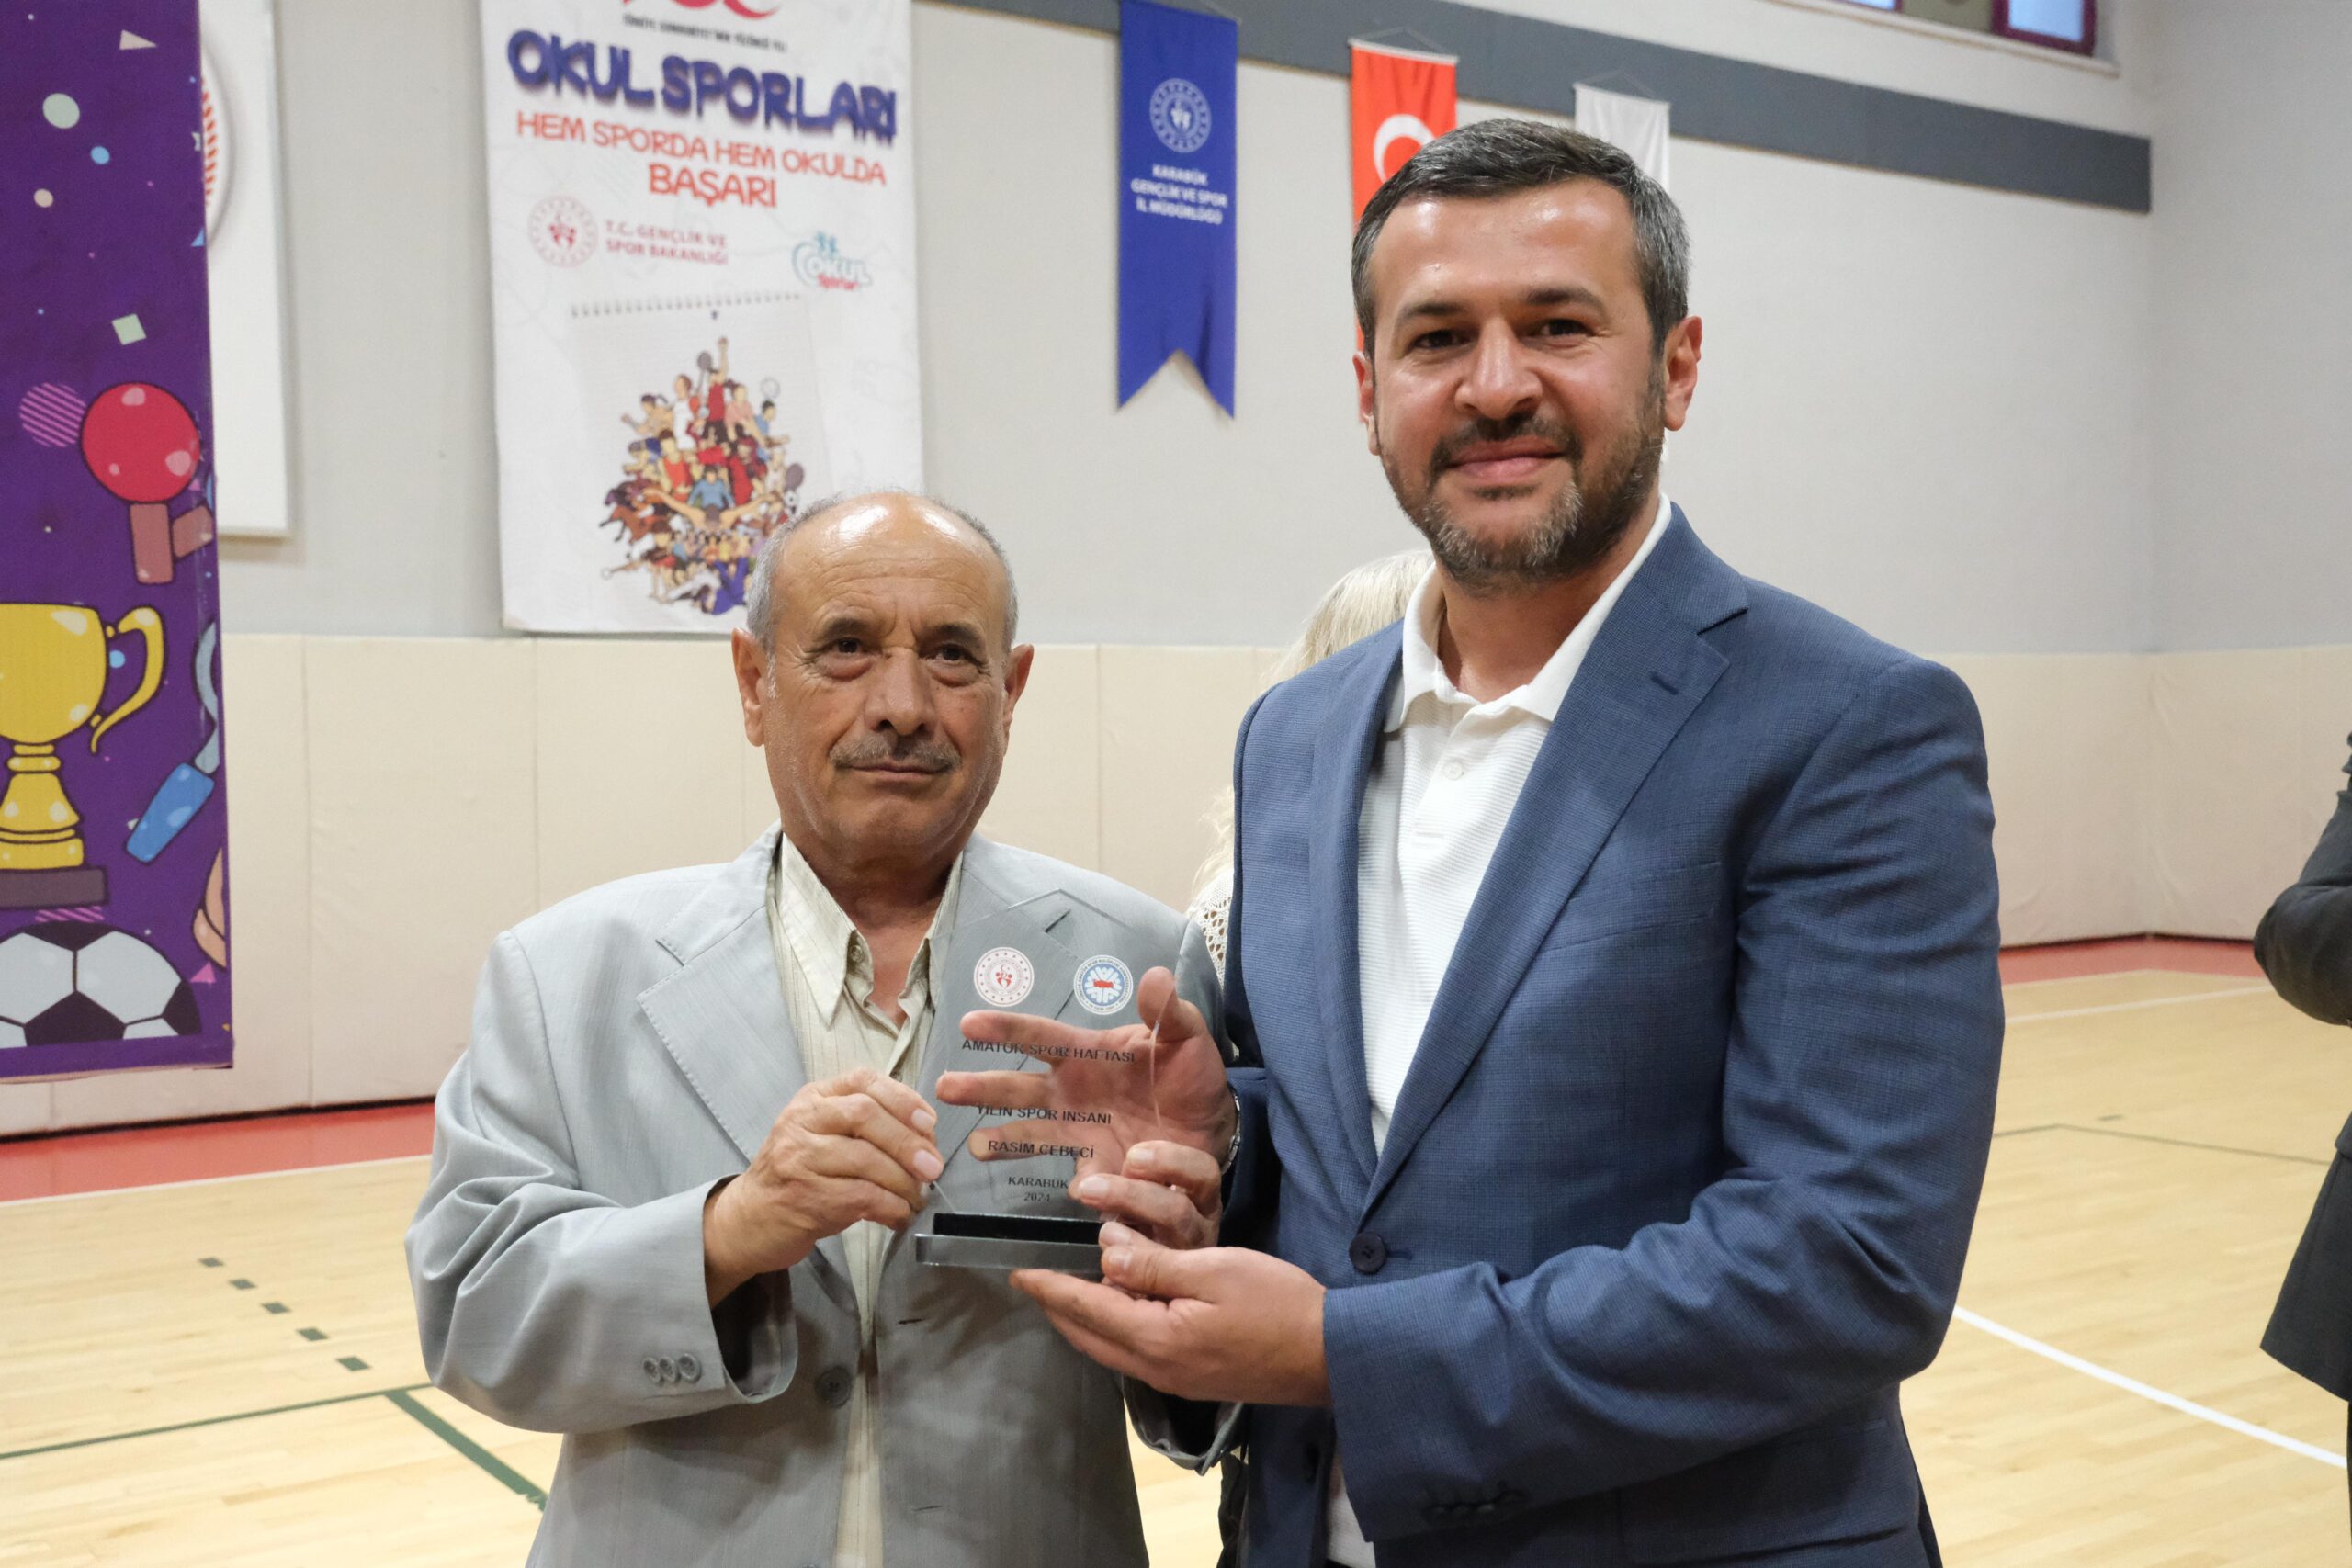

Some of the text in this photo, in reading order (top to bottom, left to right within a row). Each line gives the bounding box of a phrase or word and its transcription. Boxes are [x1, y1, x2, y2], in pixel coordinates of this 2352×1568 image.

[507, 29, 655, 107] OKUL
[662, 55, 897, 146] SPORLARI
[516, 110, 887, 186] HEM SPORDA HEM OKULDA
[649, 163, 776, 208] BAŞARI
[1197, 189, 1227, 208] SPOR
[606, 239, 644, 255] SPOR
[707, 234, 726, 247] VE
[1028, 1045, 1069, 1057] SPOR
[1073, 1048, 1136, 1063] HAFTASI
[1017, 1108, 1057, 1120] SPOR
[1039, 1144, 1094, 1158] CEBECİ
[1023, 1192, 1051, 1202] 2024
